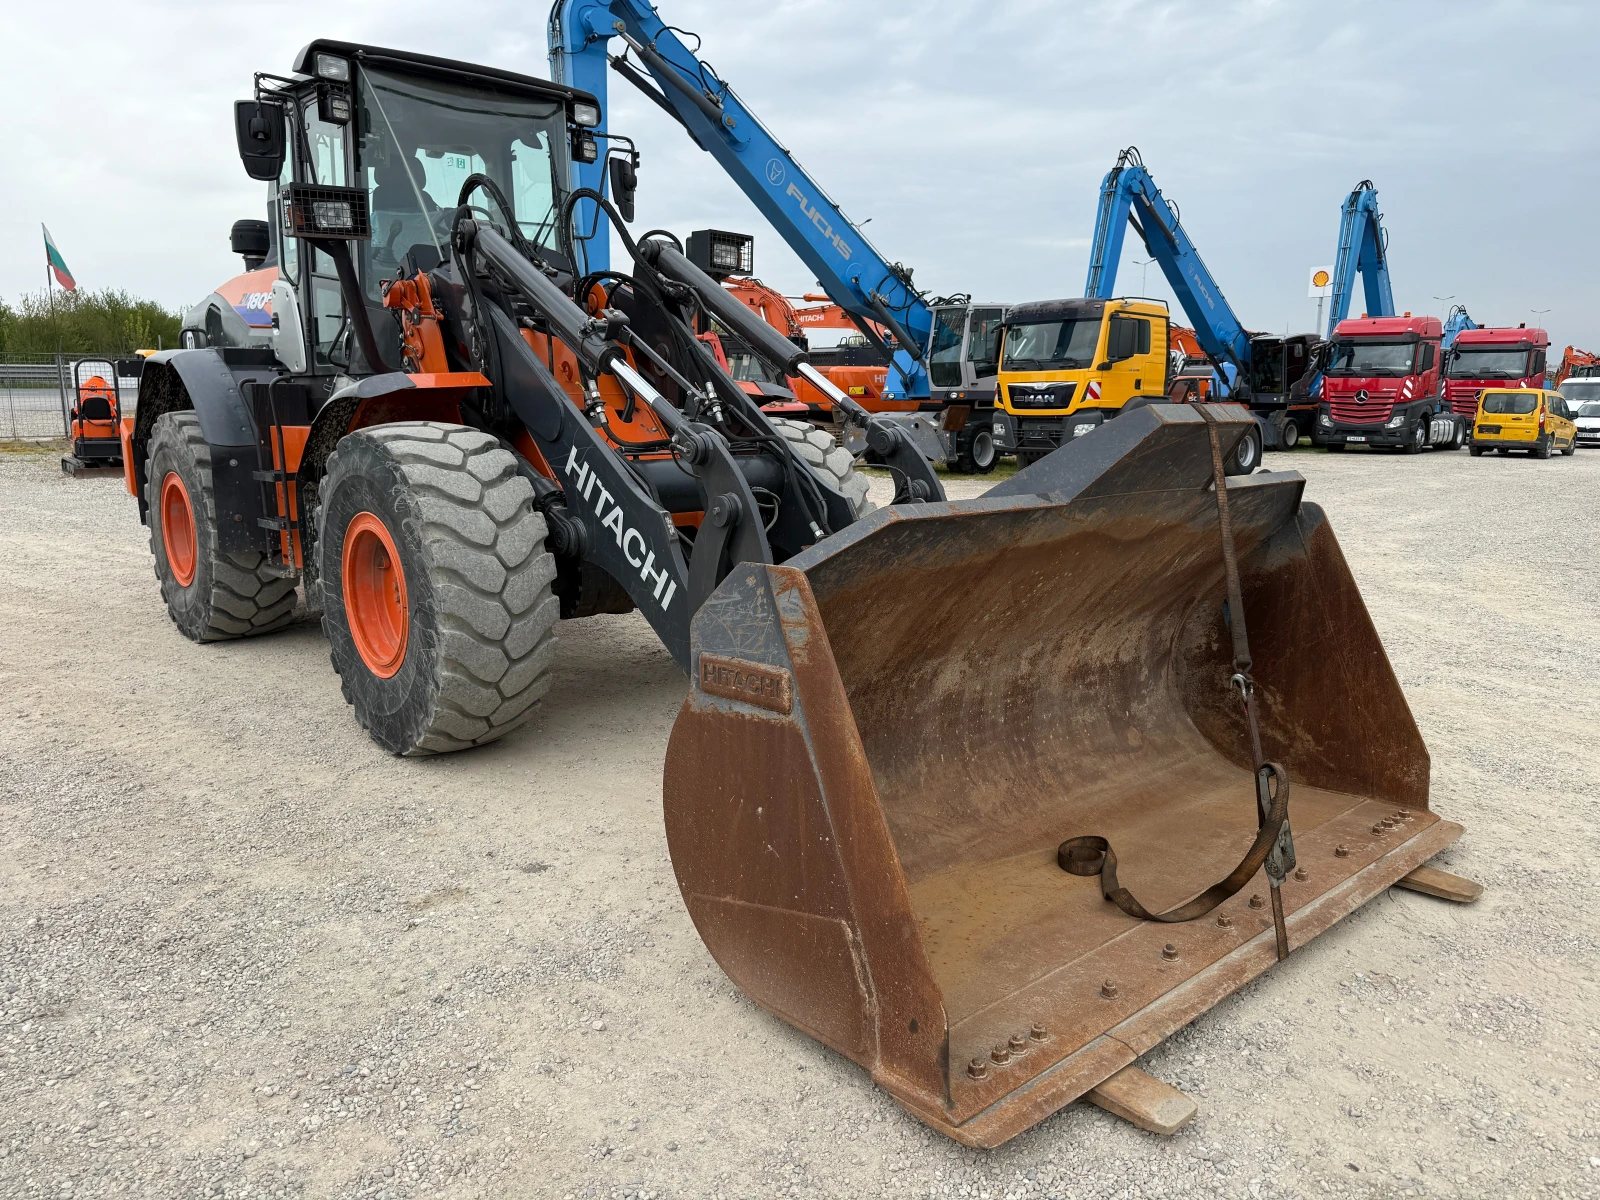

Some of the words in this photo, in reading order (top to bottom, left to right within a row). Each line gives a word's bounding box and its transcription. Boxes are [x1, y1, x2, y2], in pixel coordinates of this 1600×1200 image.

[786, 182, 853, 261] FUCHS
[799, 314, 825, 322] HITACHI
[1024, 394, 1055, 403] MAN
[565, 444, 677, 612] HITACHI
[703, 663, 780, 698] HITACHI
